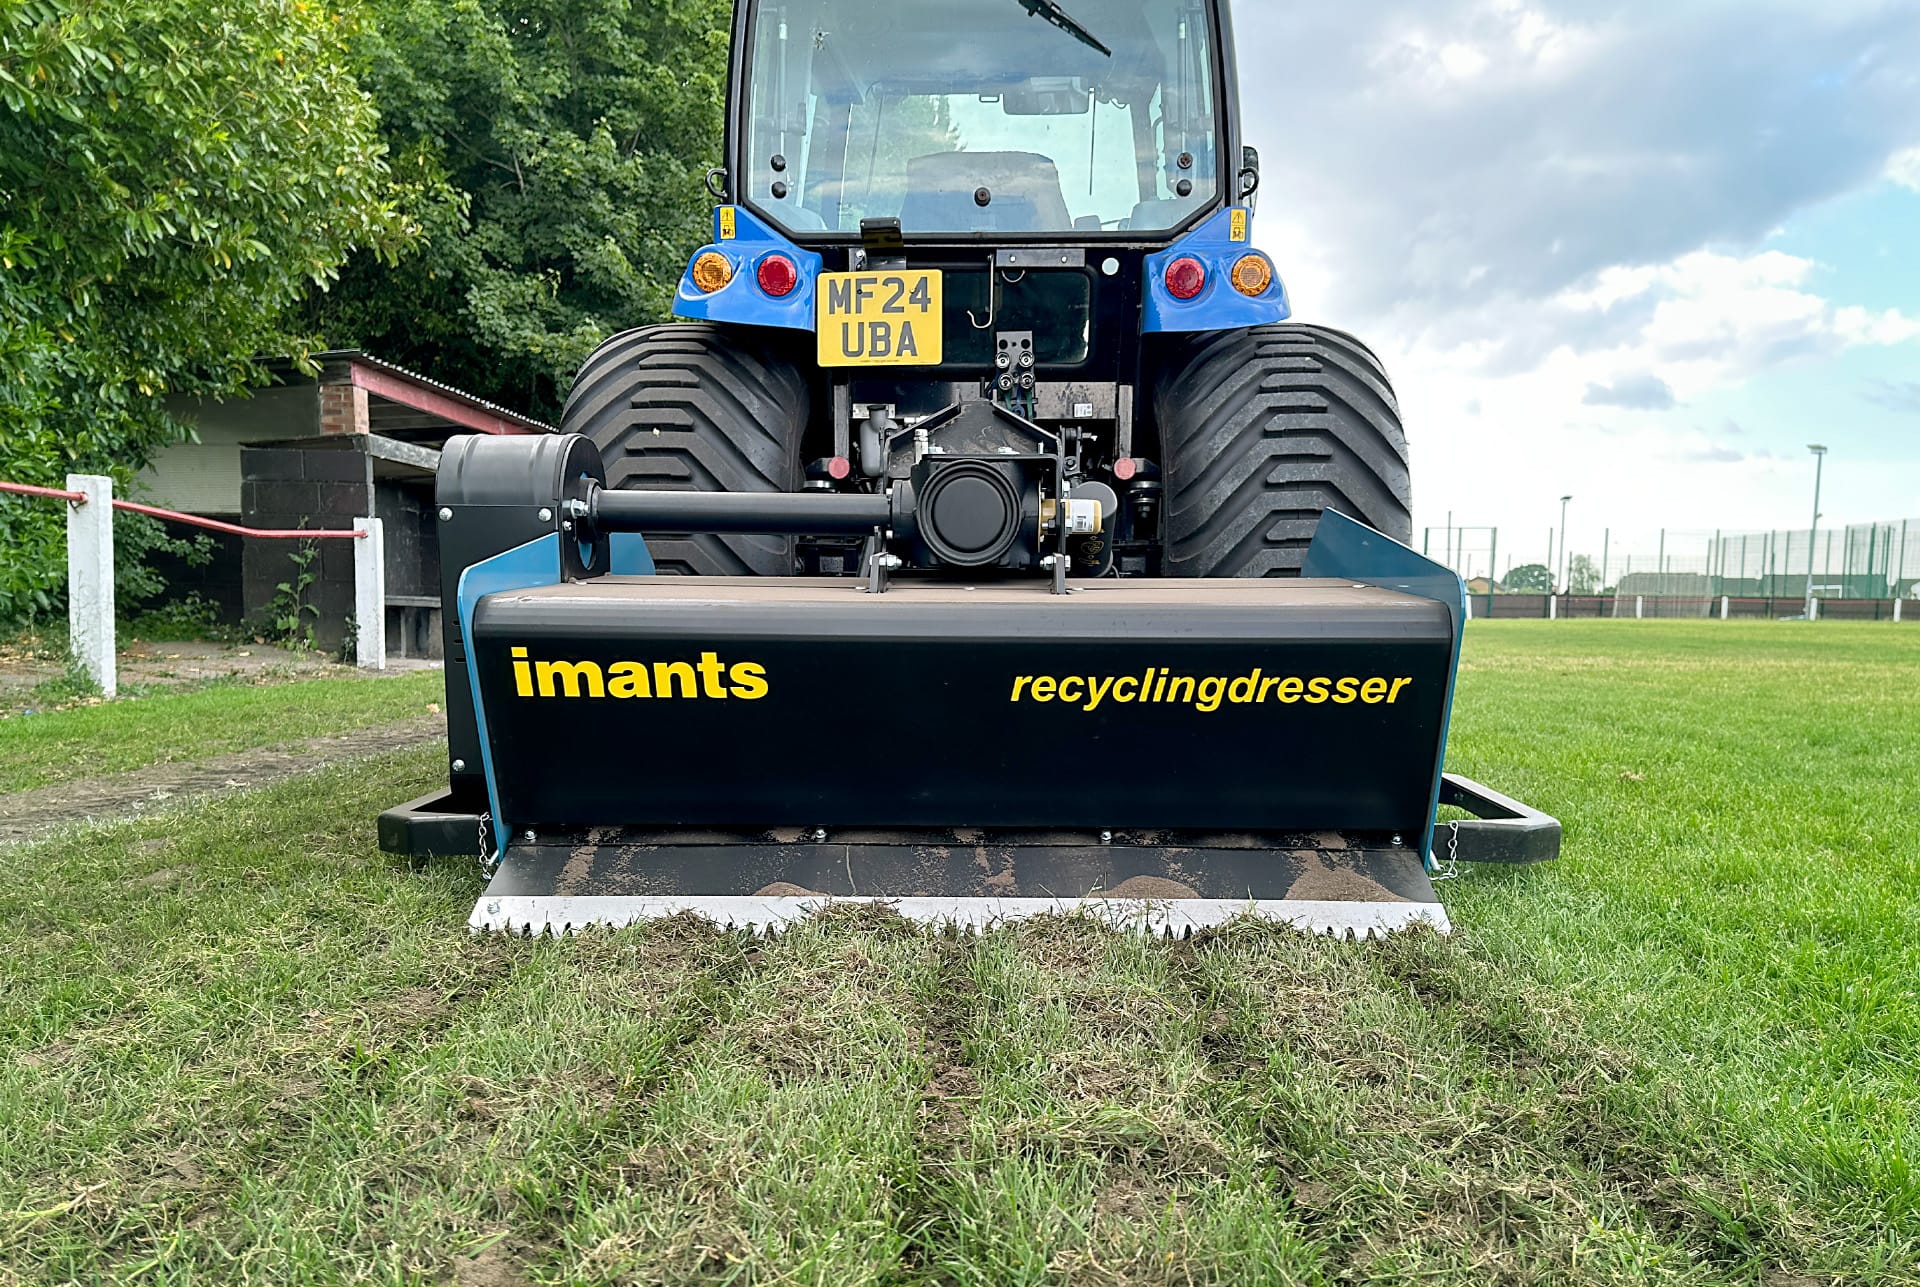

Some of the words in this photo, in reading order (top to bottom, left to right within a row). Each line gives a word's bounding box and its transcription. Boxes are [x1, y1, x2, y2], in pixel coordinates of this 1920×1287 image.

[829, 276, 932, 314] MF24
[842, 321, 918, 357] UBA
[511, 646, 769, 700] imants
[1010, 668, 1413, 712] recyclingdresser
